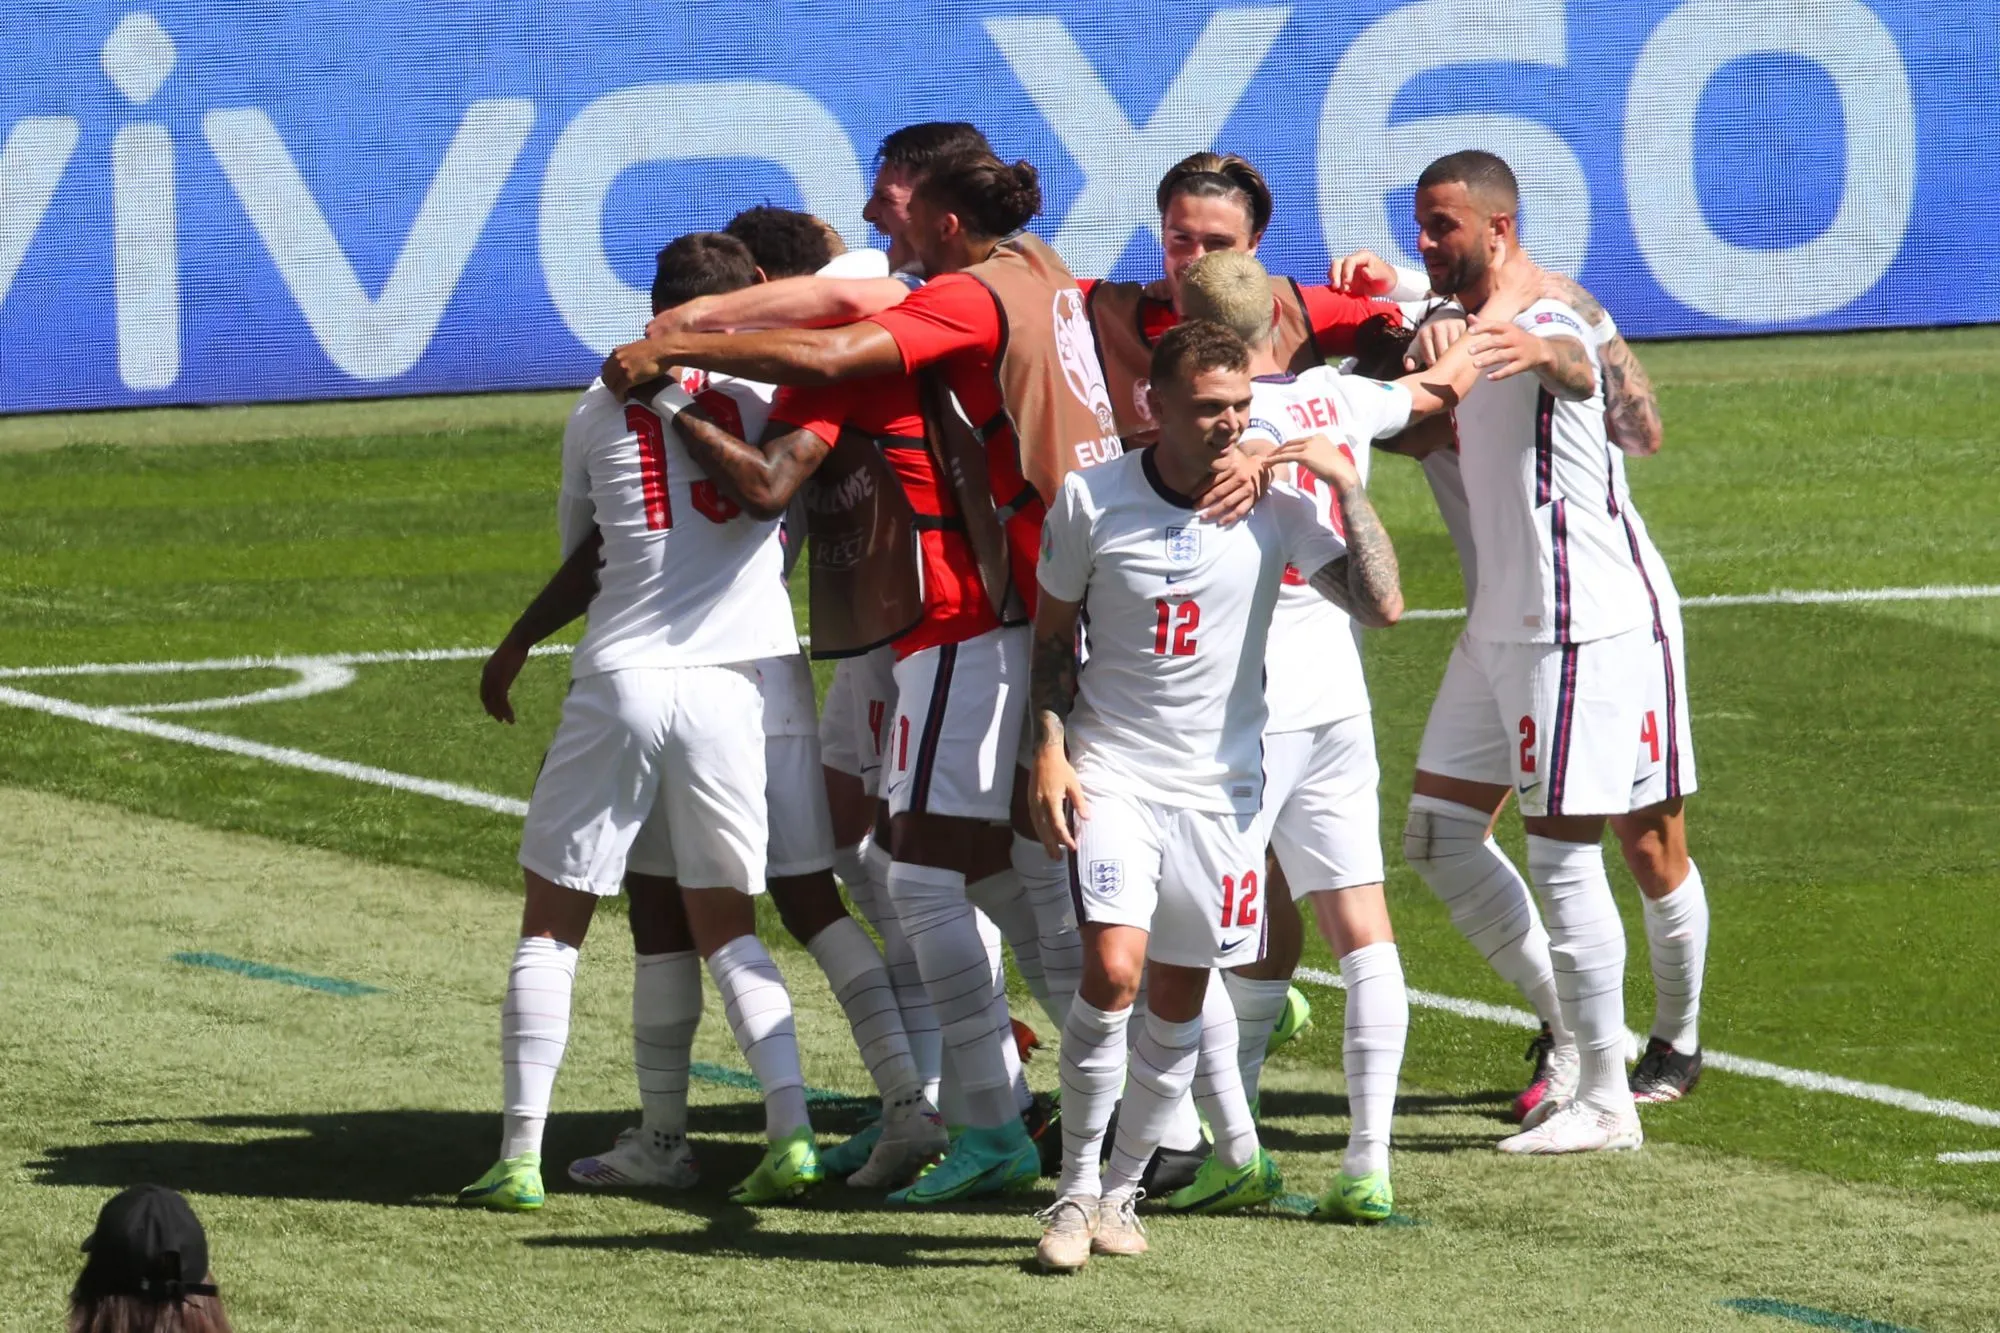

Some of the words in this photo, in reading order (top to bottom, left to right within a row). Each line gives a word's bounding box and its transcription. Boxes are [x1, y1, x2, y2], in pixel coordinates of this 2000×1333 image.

[1154, 598, 1200, 656] 12
[891, 714, 910, 772] 1
[1519, 715, 1536, 773] 2
[1220, 869, 1258, 928] 12
